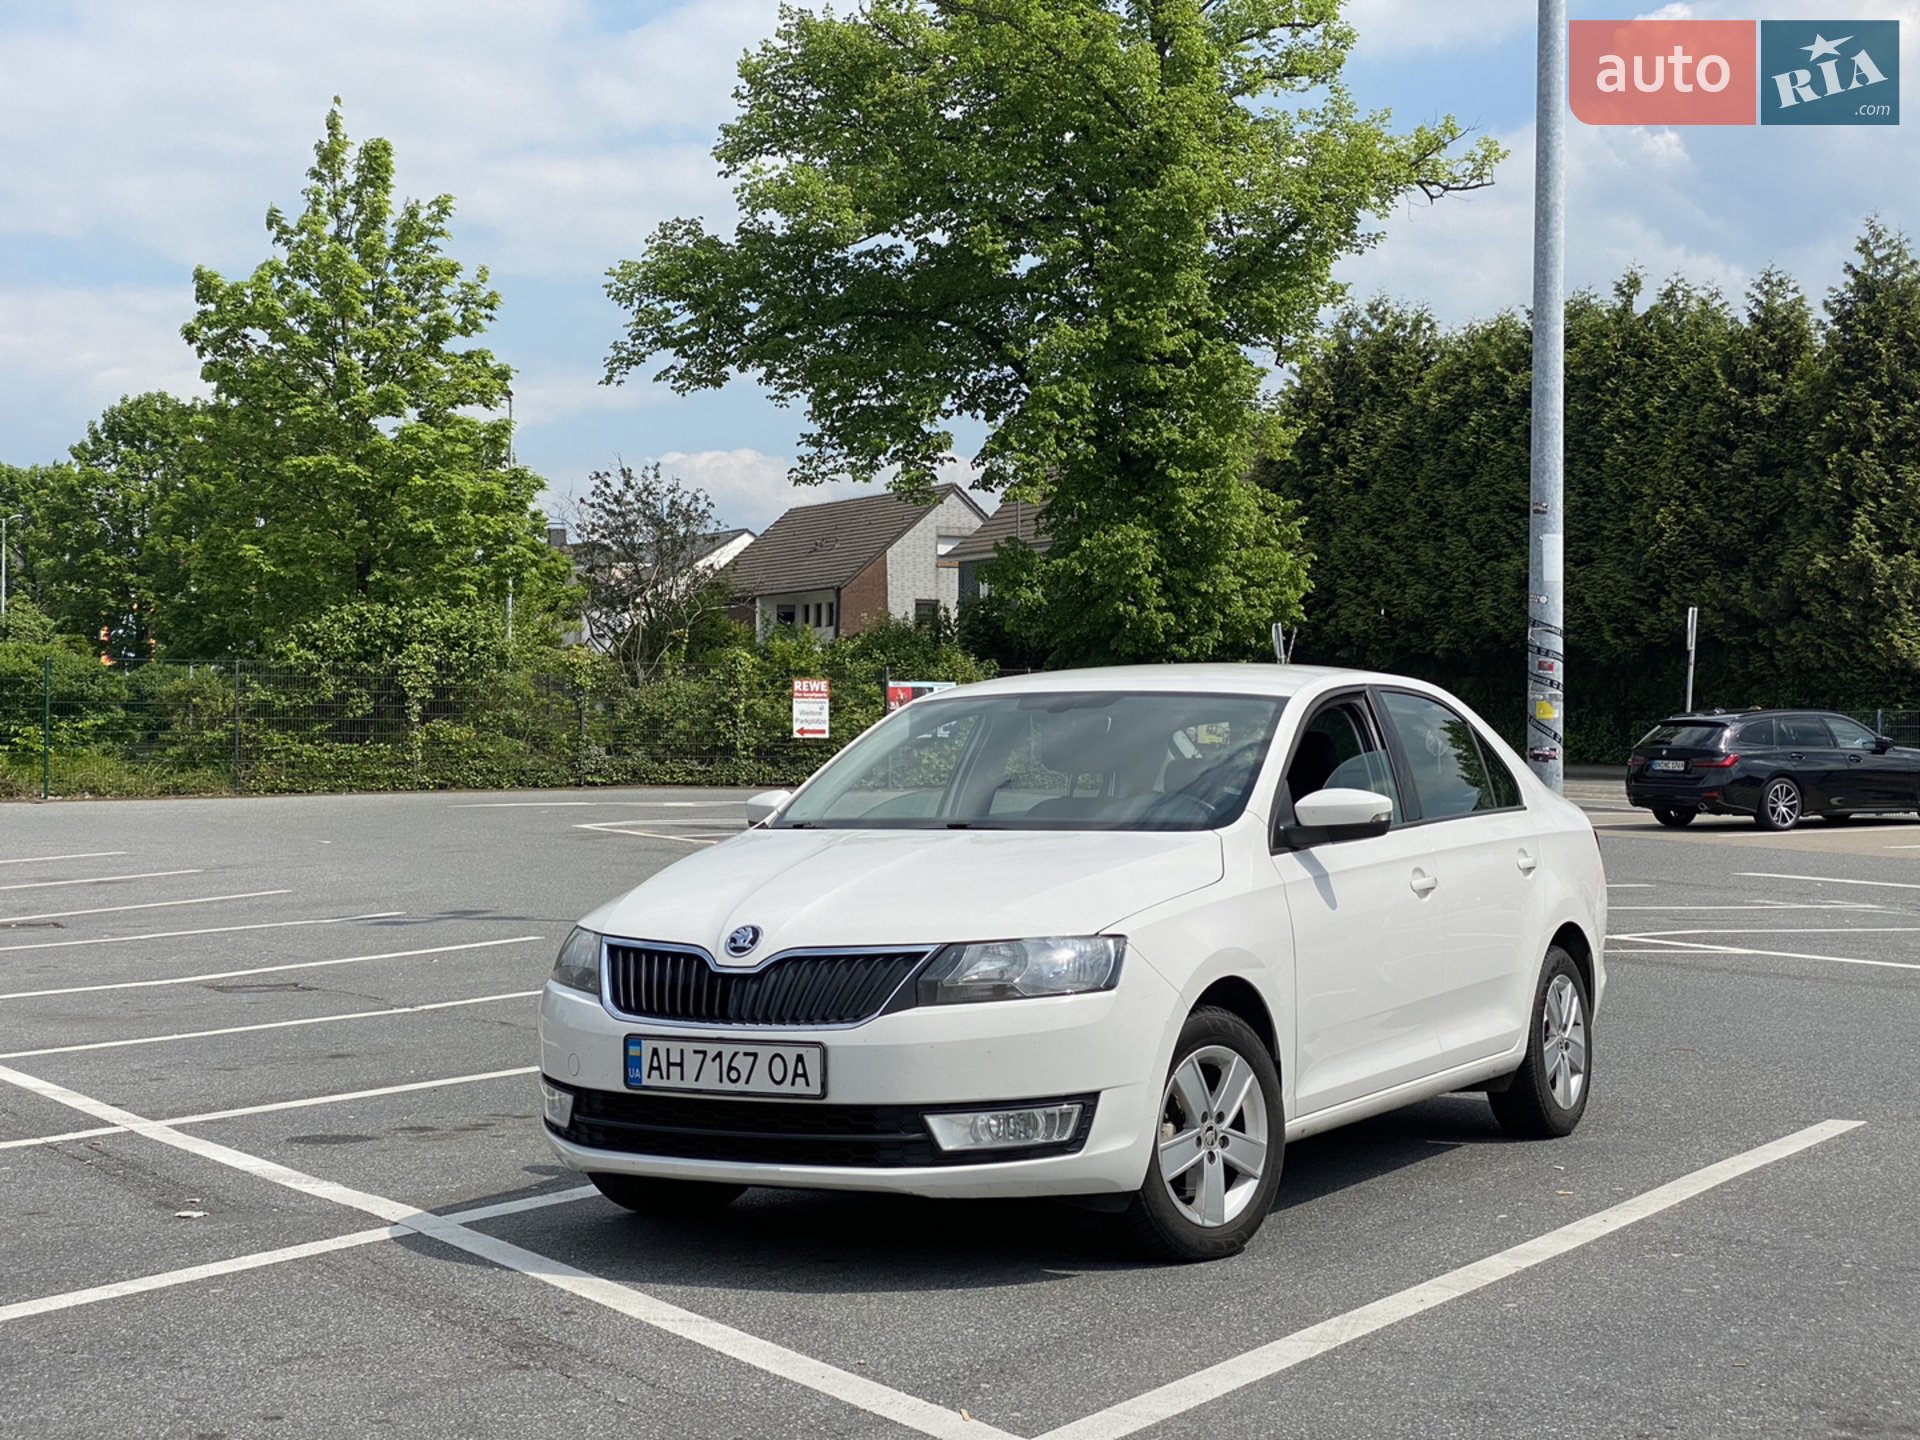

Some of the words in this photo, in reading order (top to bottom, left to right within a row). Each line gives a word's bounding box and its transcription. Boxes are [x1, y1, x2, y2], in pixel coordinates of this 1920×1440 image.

[794, 680, 828, 692] REWE
[628, 1067, 641, 1079] UA
[647, 1047, 685, 1081] AH
[692, 1050, 758, 1085] 7167
[767, 1053, 811, 1088] OA
